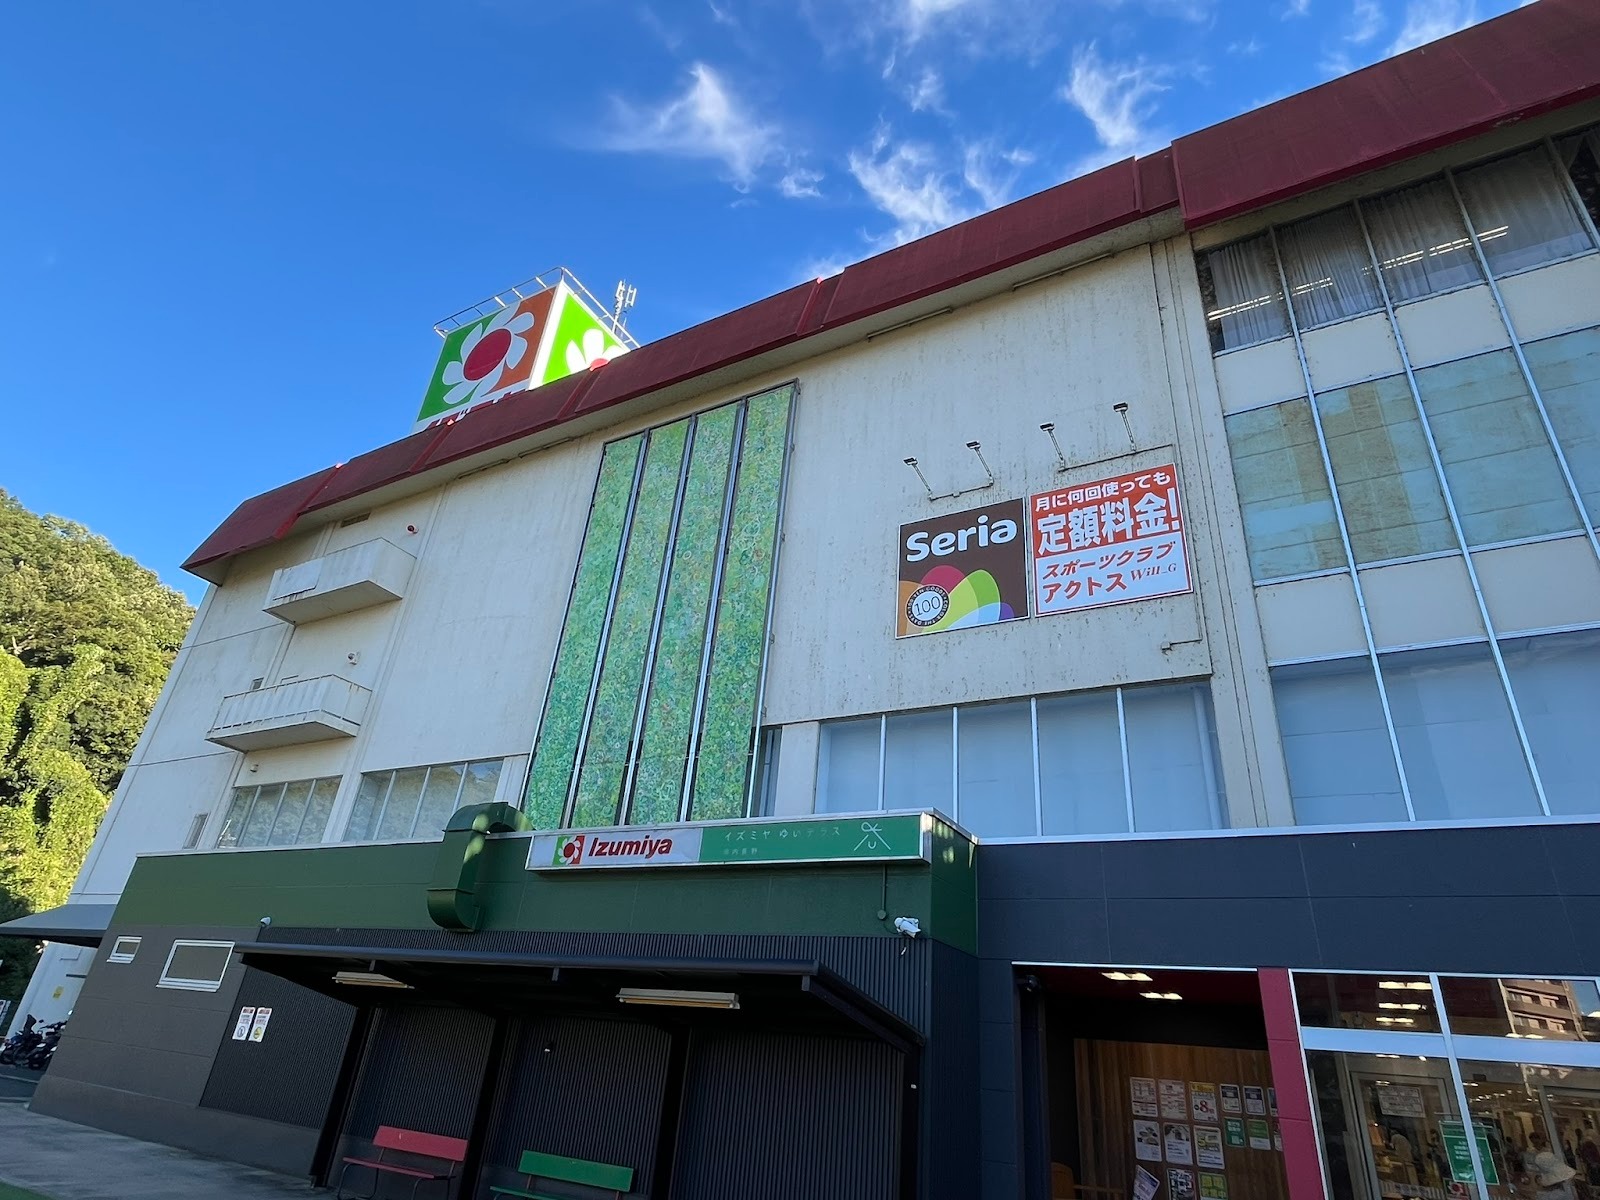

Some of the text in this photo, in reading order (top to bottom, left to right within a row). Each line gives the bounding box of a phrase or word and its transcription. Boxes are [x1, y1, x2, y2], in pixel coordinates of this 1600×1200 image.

[1035, 471, 1171, 512] 月に何回使っても
[906, 515, 1018, 562] Seria
[1037, 487, 1180, 556] 定額料金!
[1042, 541, 1176, 580] スポーツクラブ
[914, 595, 941, 617] 100
[1042, 573, 1127, 604] アクトス
[588, 835, 673, 859] Izumiya
[724, 830, 771, 841] イズミヤ
